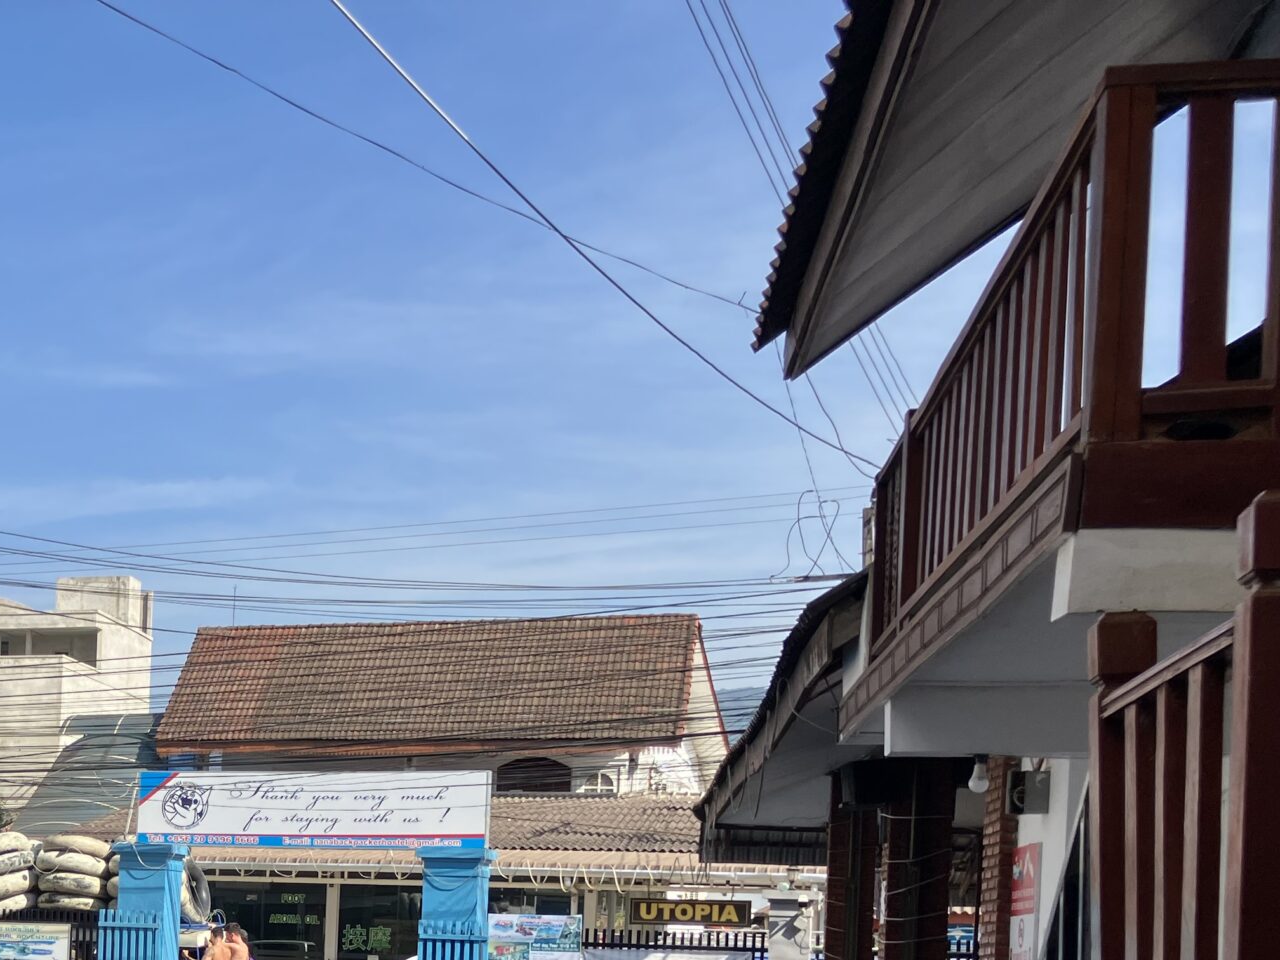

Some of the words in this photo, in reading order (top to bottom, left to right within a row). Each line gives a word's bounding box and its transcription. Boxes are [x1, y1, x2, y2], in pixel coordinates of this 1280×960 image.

[227, 780, 300, 801] Thank
[306, 796, 342, 811] you
[354, 795, 389, 811] very
[400, 786, 448, 801] much
[243, 810, 271, 832] for
[282, 812, 342, 833] staying
[354, 810, 394, 823] with
[167, 835, 191, 844] +856
[193, 835, 206, 844] 20
[234, 835, 259, 844] 8666
[281, 893, 306, 903] FOOT
[269, 913, 301, 924] AROMA
[305, 914, 320, 925] OIL
[639, 902, 740, 923] UTOPIA
[342, 924, 392, 951] 按摩
